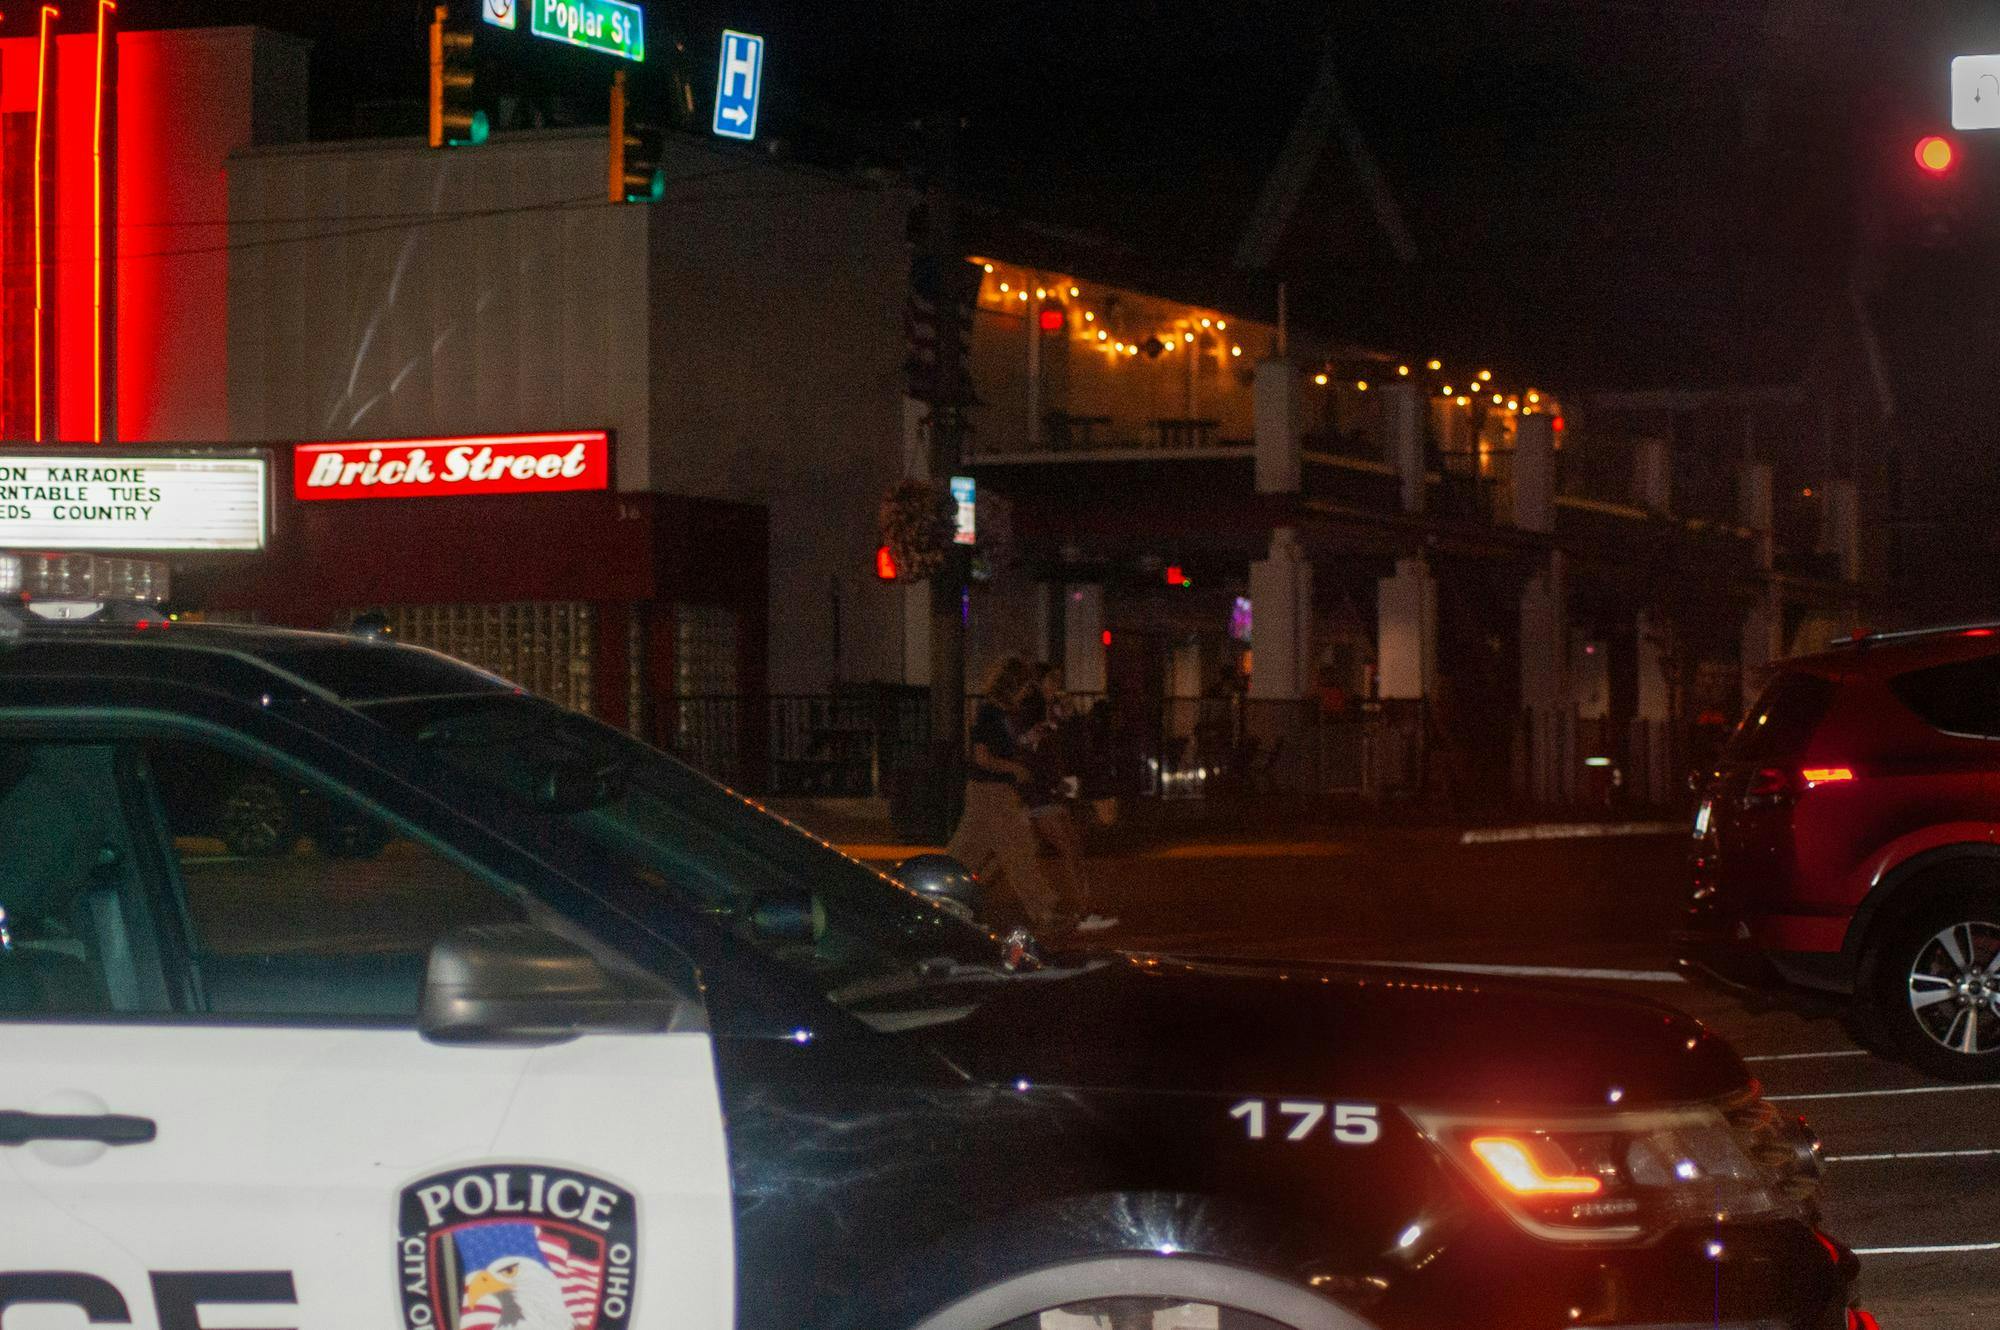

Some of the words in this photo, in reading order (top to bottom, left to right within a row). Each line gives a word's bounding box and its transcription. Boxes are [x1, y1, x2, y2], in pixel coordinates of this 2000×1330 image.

[544, 0, 604, 39] Poplar
[611, 10, 631, 45] St
[724, 37, 757, 100] H
[48, 467, 146, 483] KARAOKE
[307, 448, 435, 487] Brick
[440, 442, 587, 482] Street
[53, 505, 153, 520] COUNTRY
[109, 487, 161, 502] TUES
[1229, 1101, 1380, 1144] 175
[416, 1172, 618, 1230] POLICE
[404, 1237, 428, 1296] CITY
[603, 1242, 631, 1319] OHIO
